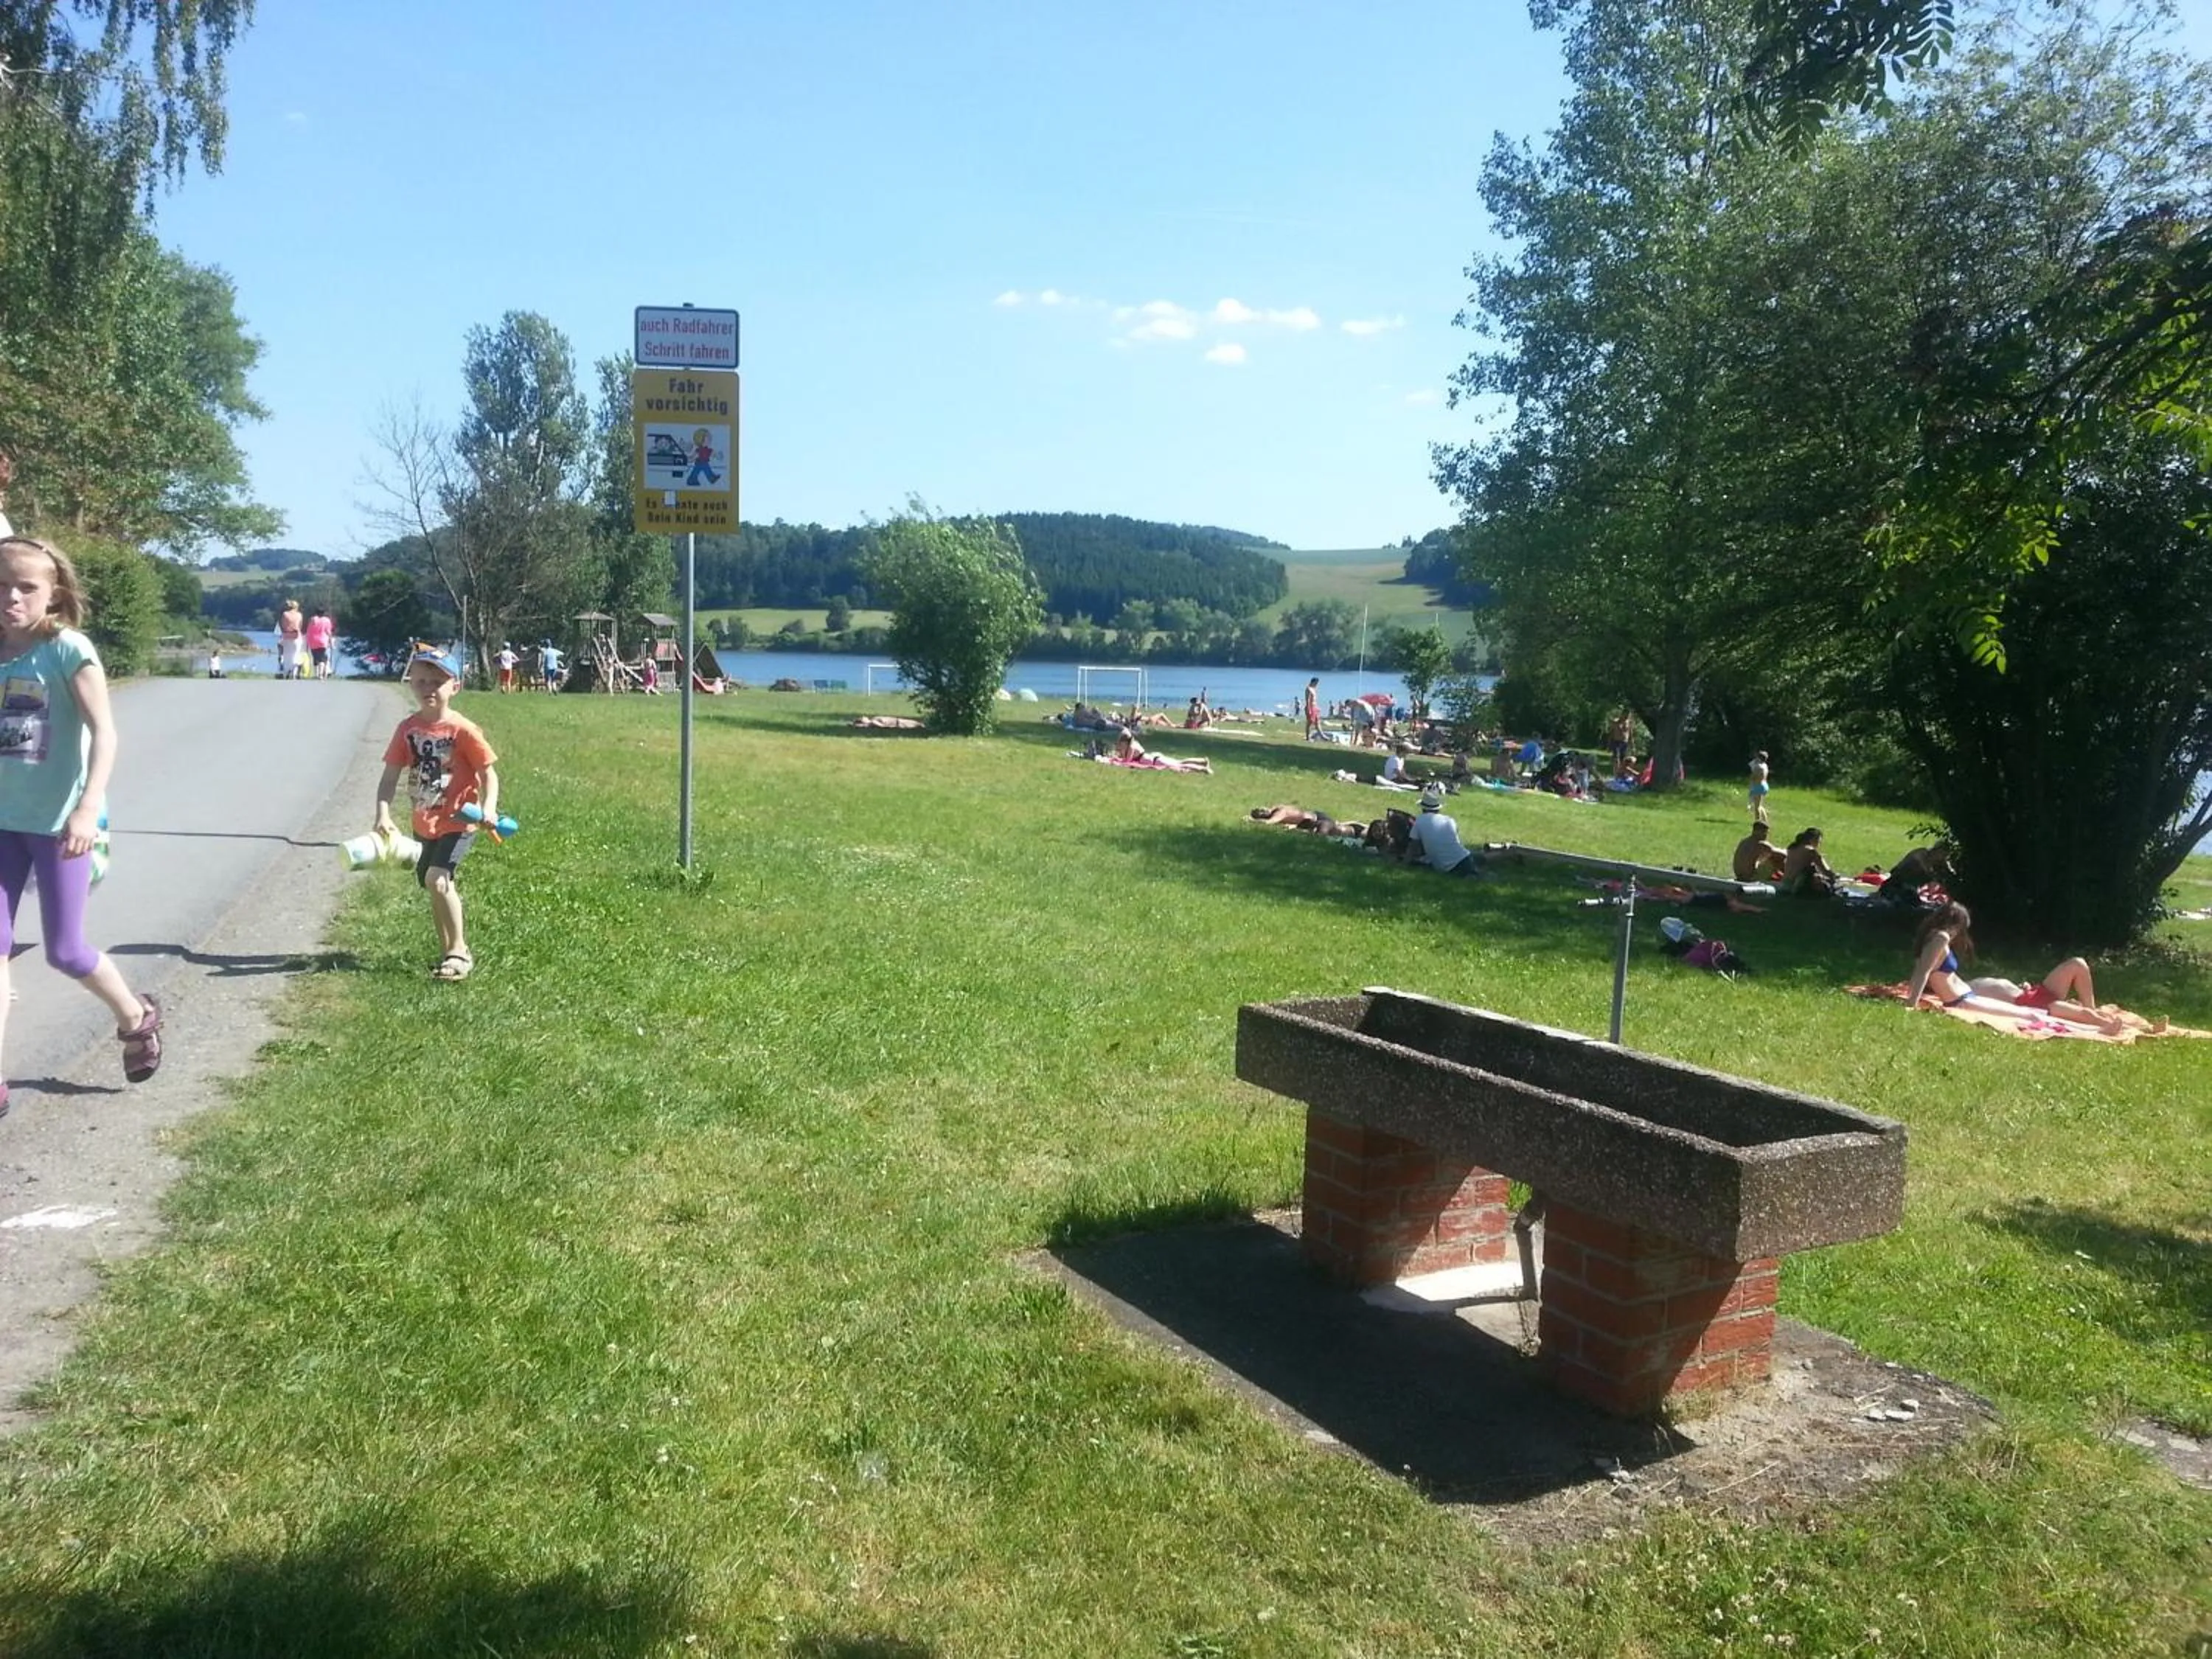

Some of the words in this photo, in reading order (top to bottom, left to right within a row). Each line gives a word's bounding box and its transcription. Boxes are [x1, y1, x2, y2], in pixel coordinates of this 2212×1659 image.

[640, 318, 669, 332] auch
[673, 318, 733, 334] Radfahrer
[645, 341, 684, 357] Schritt
[690, 342, 729, 359] fahren
[669, 378, 703, 393] Fahr
[646, 396, 728, 415] vorsichtig
